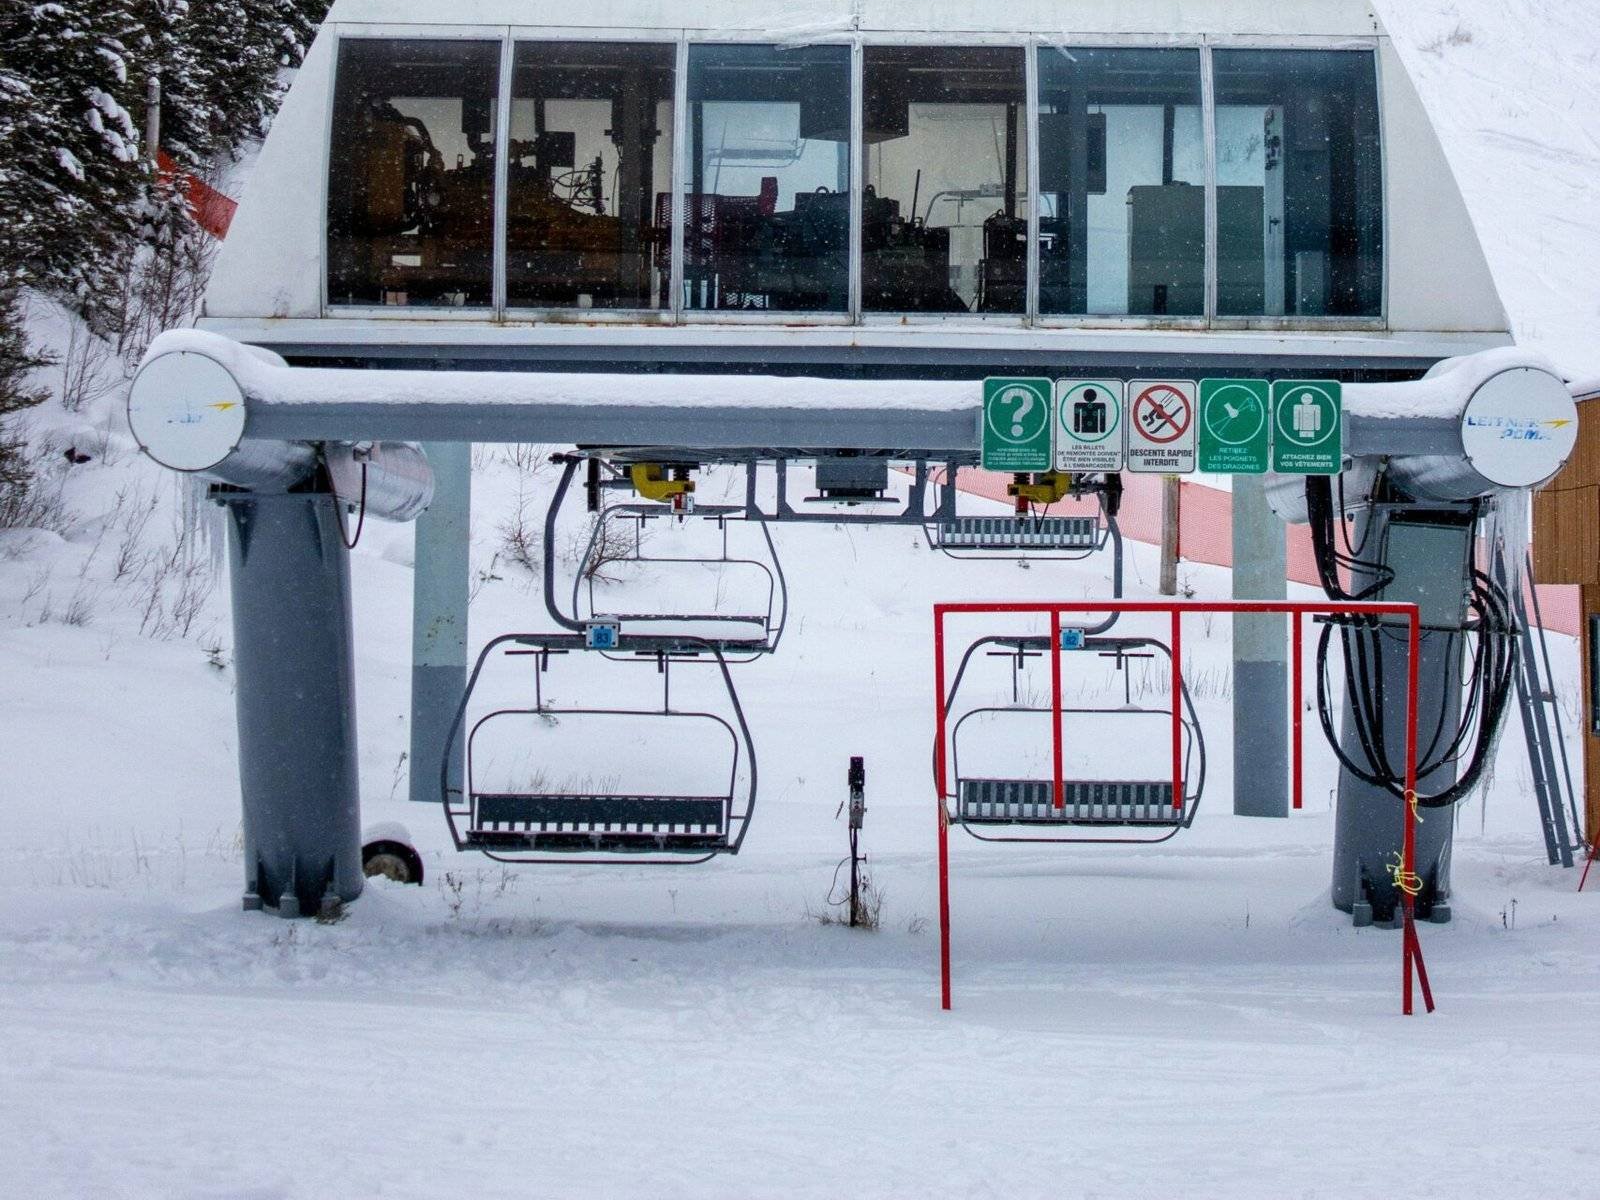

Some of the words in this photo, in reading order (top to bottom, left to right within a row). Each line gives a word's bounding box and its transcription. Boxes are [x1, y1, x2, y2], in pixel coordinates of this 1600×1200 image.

[1130, 449, 1166, 457] DESCENTE
[1167, 449, 1193, 458] RAPIDE
[1143, 459, 1179, 467] INTERDITE
[596, 632, 609, 644] 83
